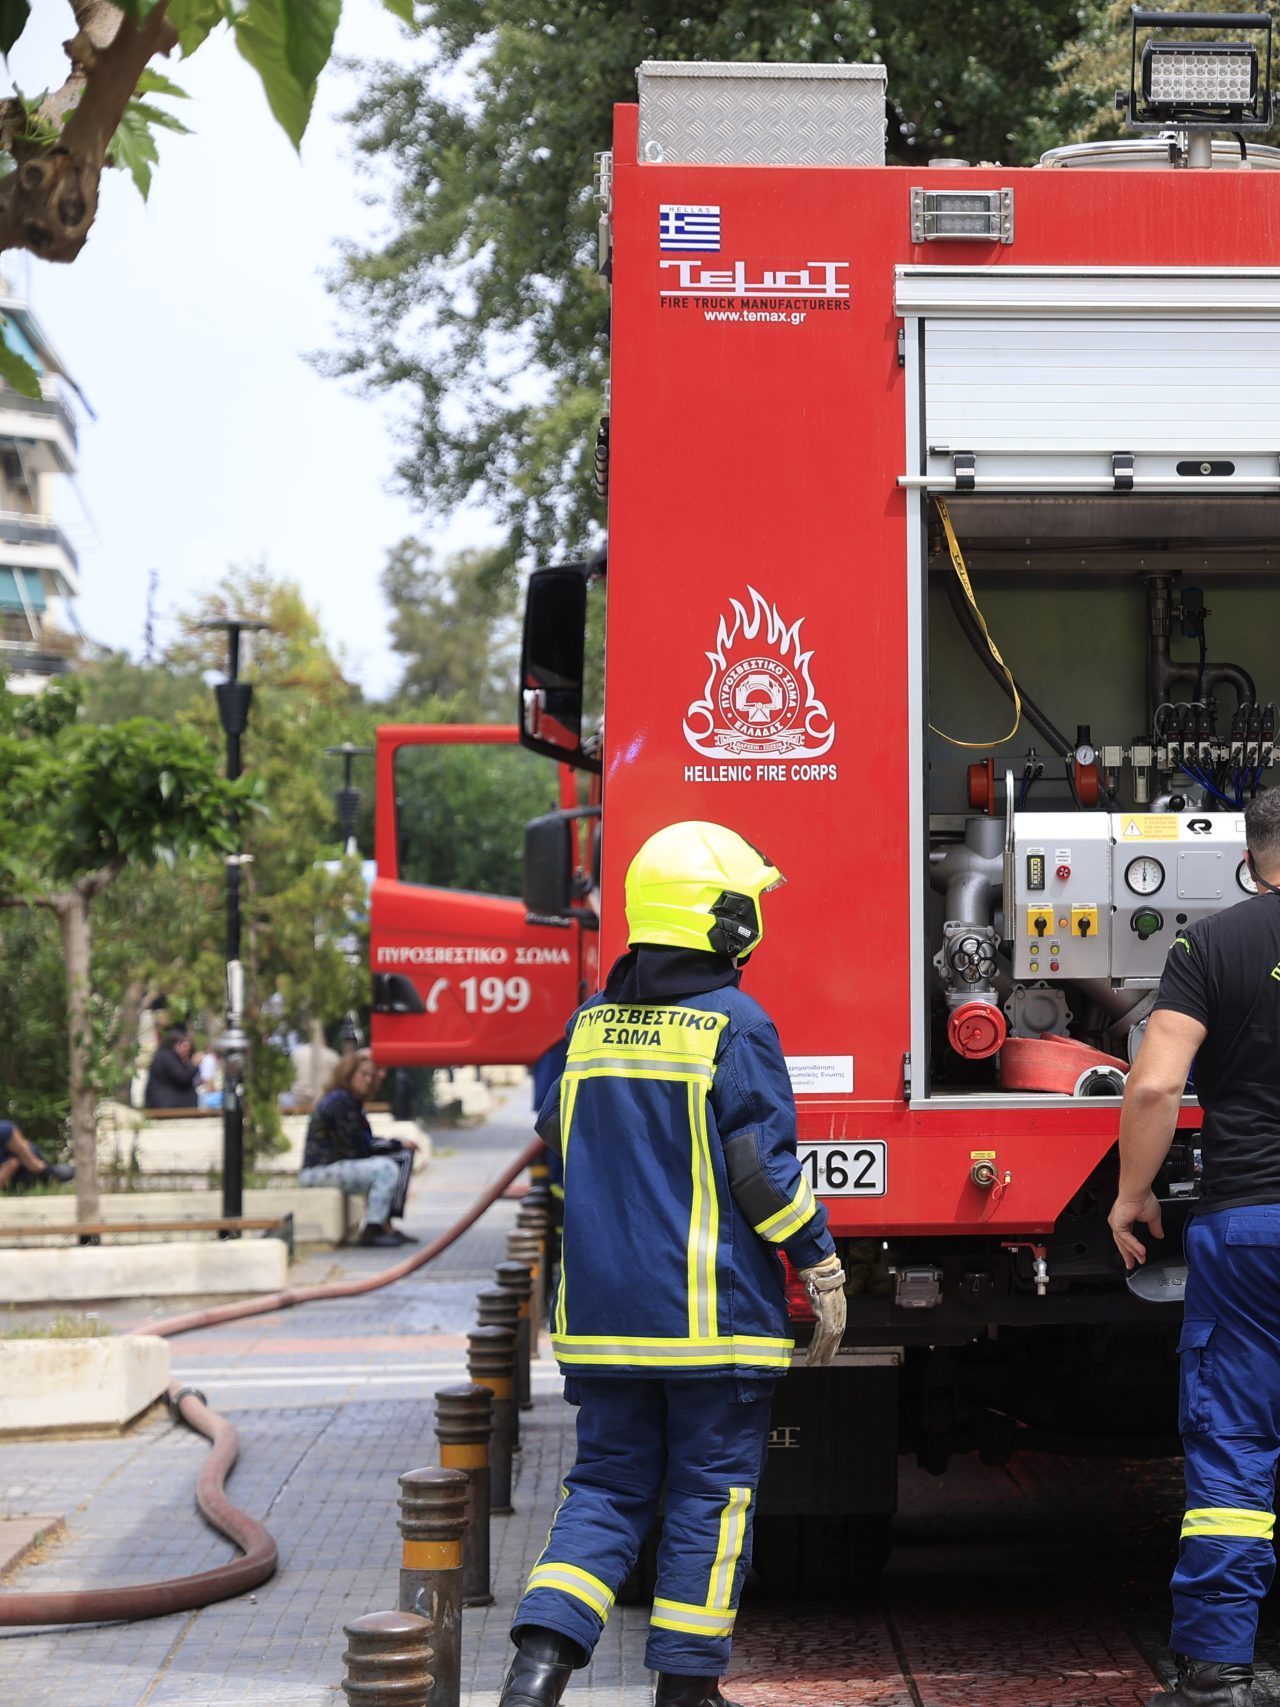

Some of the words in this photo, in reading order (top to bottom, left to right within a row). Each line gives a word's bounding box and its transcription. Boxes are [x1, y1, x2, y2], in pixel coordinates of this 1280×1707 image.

[669, 206, 711, 214] HELLAS
[660, 297, 690, 309] FIRE
[694, 298, 735, 310] TRUCK
[740, 298, 850, 311] MANUFACTURERS
[704, 310, 807, 323] www.temax.gr
[721, 659, 784, 708] ΠΥΡΟΣΒΕΣΤΙΚΟ
[782, 674, 798, 708] ΣΩΜΑ
[733, 720, 784, 737] ΕΛΛΑΔΑΣ
[684, 765, 752, 782] HELLENIC
[756, 765, 787, 781] FIRE
[791, 764, 838, 781] CORPS
[377, 946, 508, 964] ΠΥΡΟΣΒΕΣΤΙΚΟ
[514, 946, 571, 965] ΣΩΜΑ
[459, 976, 531, 1014] 199
[577, 1008, 718, 1031] ΠΥΡΟΣΒΕΣΤΙΚΟ
[602, 1027, 662, 1046] ΣΩΜΑ
[800, 1149, 877, 1189] 162
